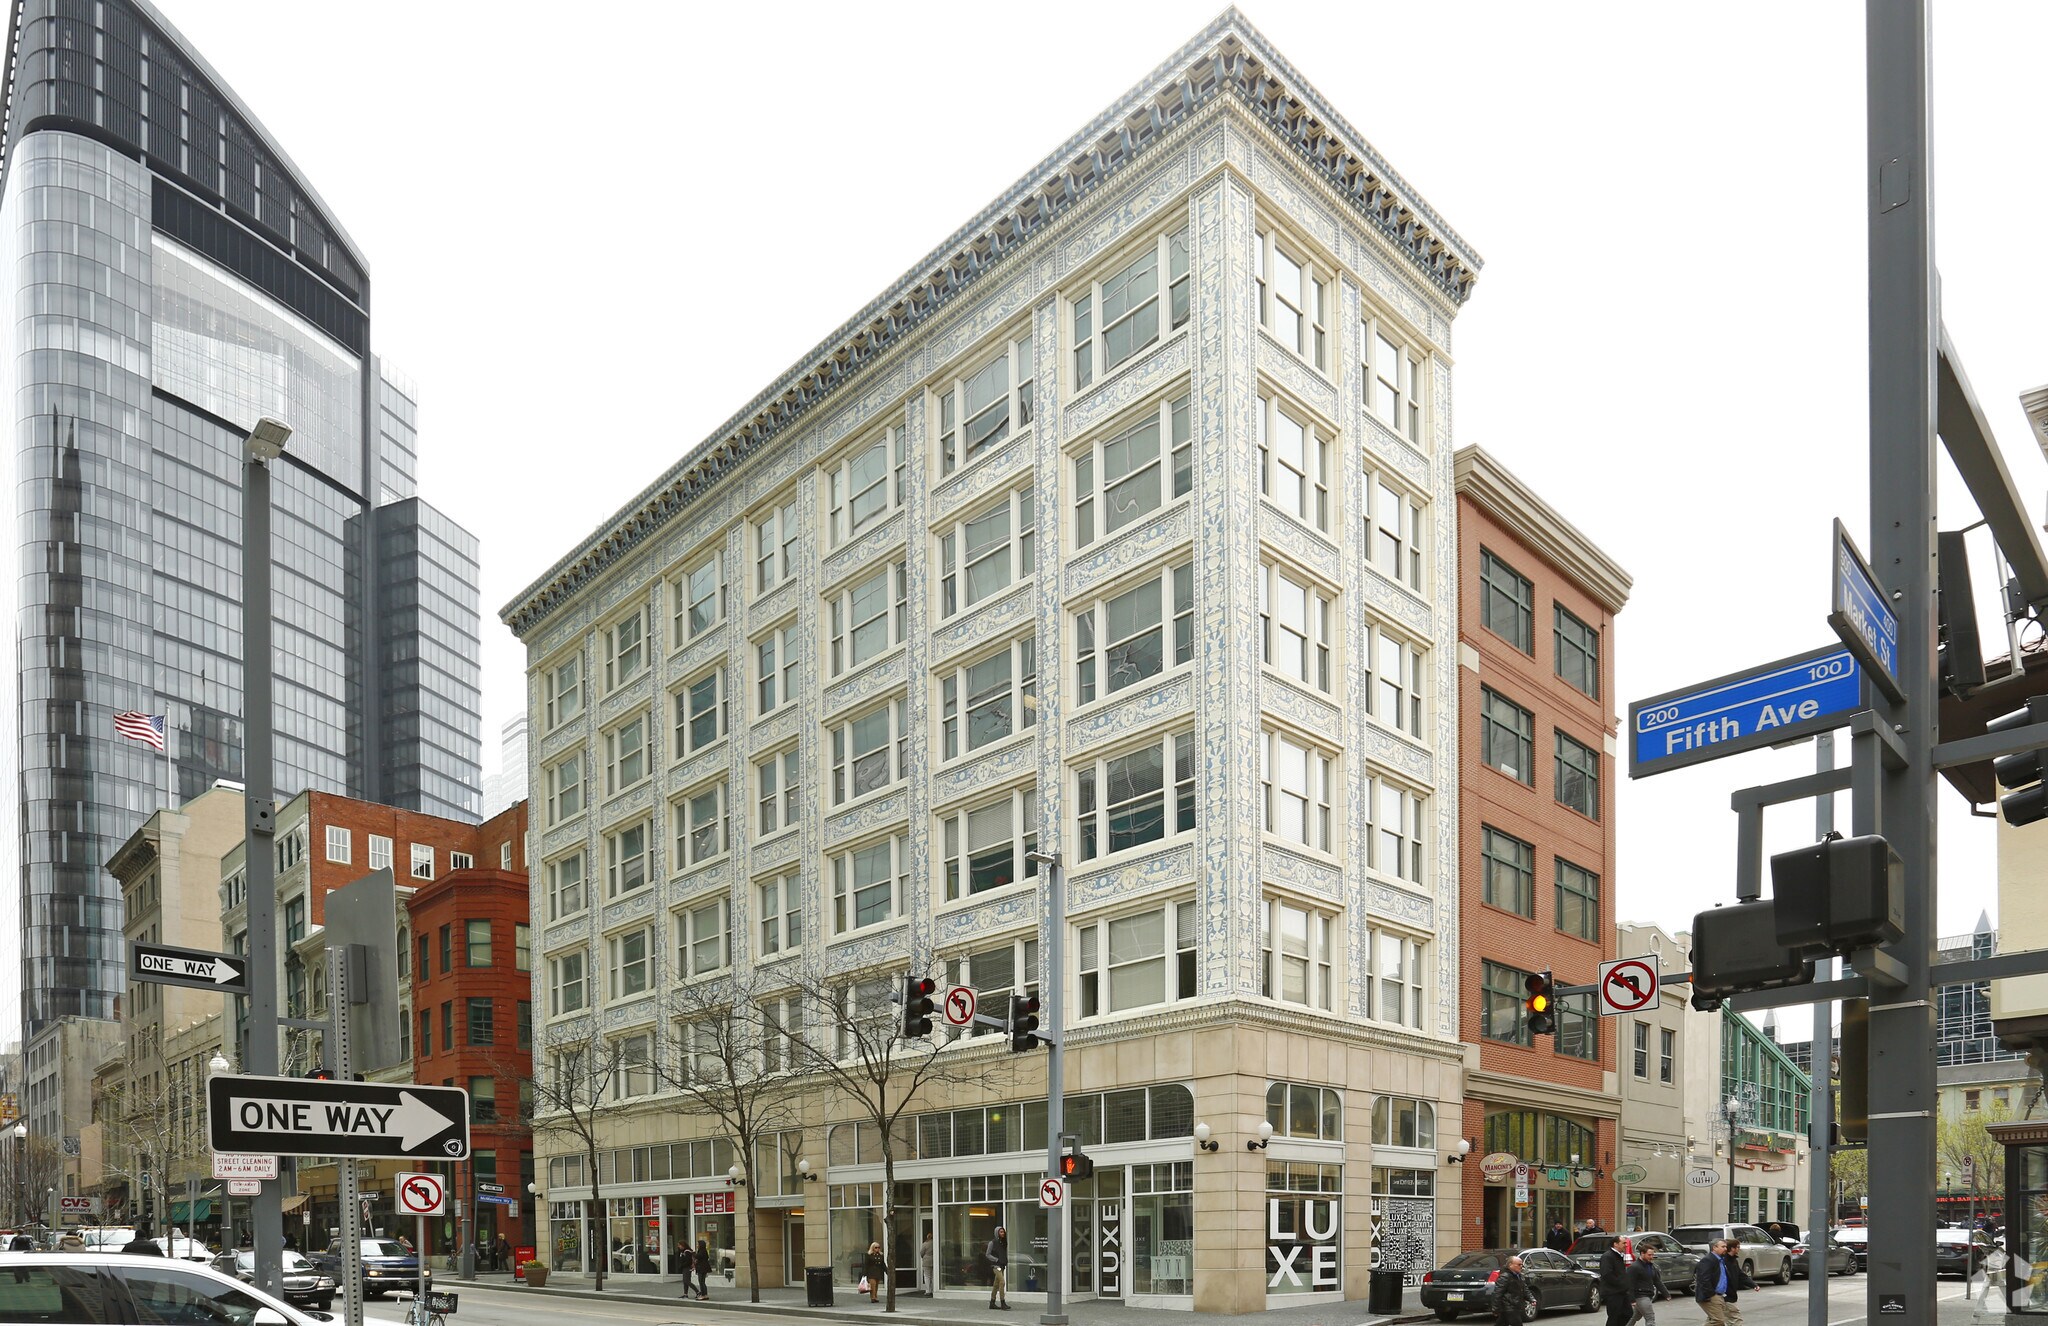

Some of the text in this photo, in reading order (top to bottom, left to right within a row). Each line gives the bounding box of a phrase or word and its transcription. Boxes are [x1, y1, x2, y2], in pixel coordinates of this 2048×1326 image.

[1843, 583, 1891, 672] Market St
[1808, 660, 1842, 681] 100
[1646, 707, 1679, 727] 200
[1666, 699, 1819, 755] Fifth Ave
[142, 956, 216, 976] ONE WAY
[240, 1101, 395, 1134] ONE WAY
[1484, 1163, 1512, 1172] MANCINI'S
[1692, 1176, 1713, 1184] SUSHI
[61, 1197, 91, 1208] CVS
[1370, 1199, 1381, 1269] UXE
[1102, 1204, 1119, 1292] LUXE
